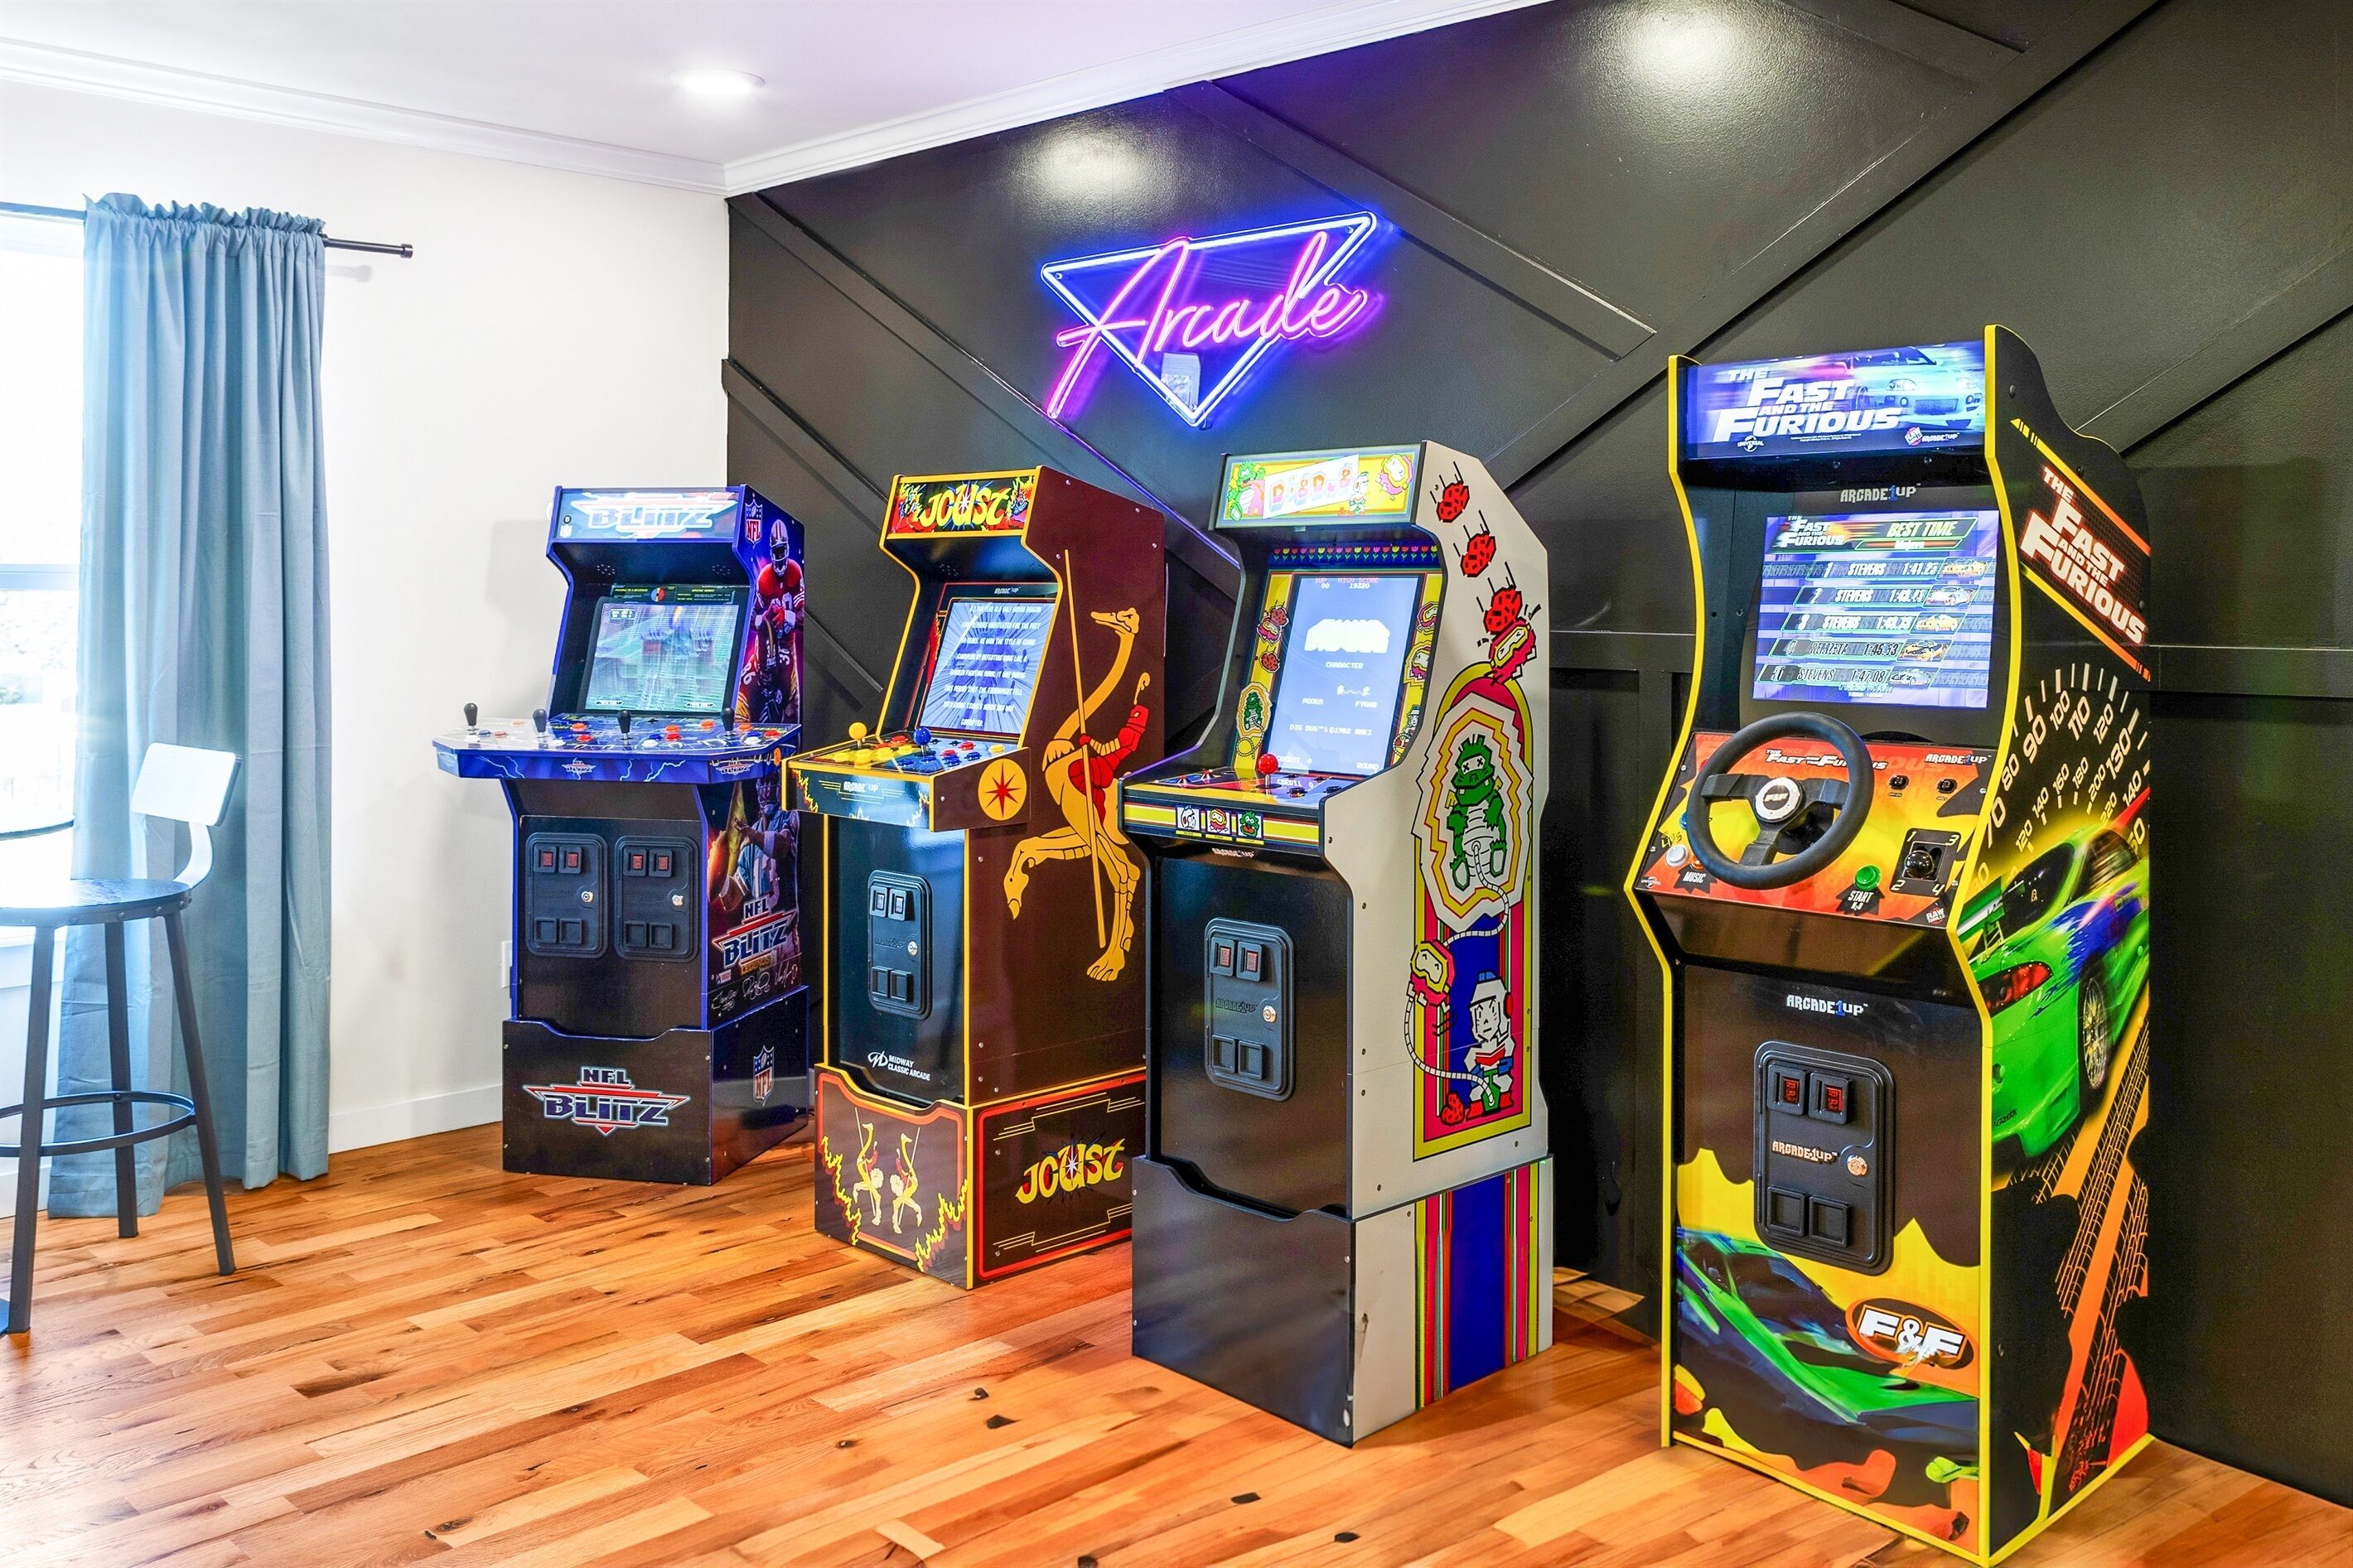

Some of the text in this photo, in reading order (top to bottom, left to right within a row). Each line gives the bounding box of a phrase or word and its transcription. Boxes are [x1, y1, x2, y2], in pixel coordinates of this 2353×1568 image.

[1047, 231, 1367, 419] Arcade
[1727, 367, 1769, 382] THE
[1747, 376, 1855, 407] FAST
[1758, 401, 1834, 416] AND THE
[1712, 407, 1902, 442] FURIOUS
[1840, 485, 1917, 503] ARCADE1UP
[2041, 466, 2074, 502] THE
[589, 505, 713, 528] BLITZ
[1796, 519, 1831, 531] FAST
[746, 519, 761, 539] NFL
[1887, 521, 1958, 537] BEST TIME
[2051, 499, 2124, 581] FAST
[1780, 533, 1845, 548] FURIOUS
[1824, 562, 1834, 578] 1
[1848, 563, 1887, 576] STEVENS
[2056, 540, 2109, 586] AND THE
[2020, 511, 2146, 644] FURIOUS
[1834, 589, 1874, 602] STEVENS
[1823, 616, 1861, 630] STEVENS
[1326, 661, 1364, 669] CHARACTER
[1797, 668, 1836, 682] STEVENS
[1851, 670, 1886, 683] 1:47.08
[2050, 690, 2070, 731] 100
[2067, 696, 2091, 741] 110
[2093, 703, 2114, 745] 120
[2022, 715, 2047, 764] 90
[1766, 753, 1806, 764] FAST
[1925, 754, 1988, 765] ARCADE1UP
[2105, 728, 2132, 779] 130
[1356, 762, 1379, 770] ROUND
[2001, 753, 2020, 791] 80
[2072, 756, 2089, 789] 180
[2052, 763, 2069, 794] 160
[2088, 764, 2105, 803] 200
[2032, 787, 2049, 818] 140
[1906, 831, 1959, 846] 1 3
[2016, 819, 2032, 852] 120
[1683, 871, 1707, 884] MUSIC
[1891, 880, 1945, 895] 2 4
[1848, 890, 1874, 903] START
[744, 897, 770, 919] NFL
[1926, 908, 1945, 919] RAW
[724, 917, 790, 967] BLITZ
[1786, 994, 1865, 1016] ARCADE1UP
[887, 1063, 931, 1082] CLASSIC ARCADE
[889, 1054, 915, 1069] MIDWAY
[582, 1068, 631, 1084] NFL
[754, 1070, 774, 1098] NFL
[544, 1095, 669, 1127] BLITZ
[1772, 1141, 1834, 1163] ARCADE1UP
[1015, 1138, 1125, 1204] JOUST
[1859, 1305, 1967, 1358] F&F
